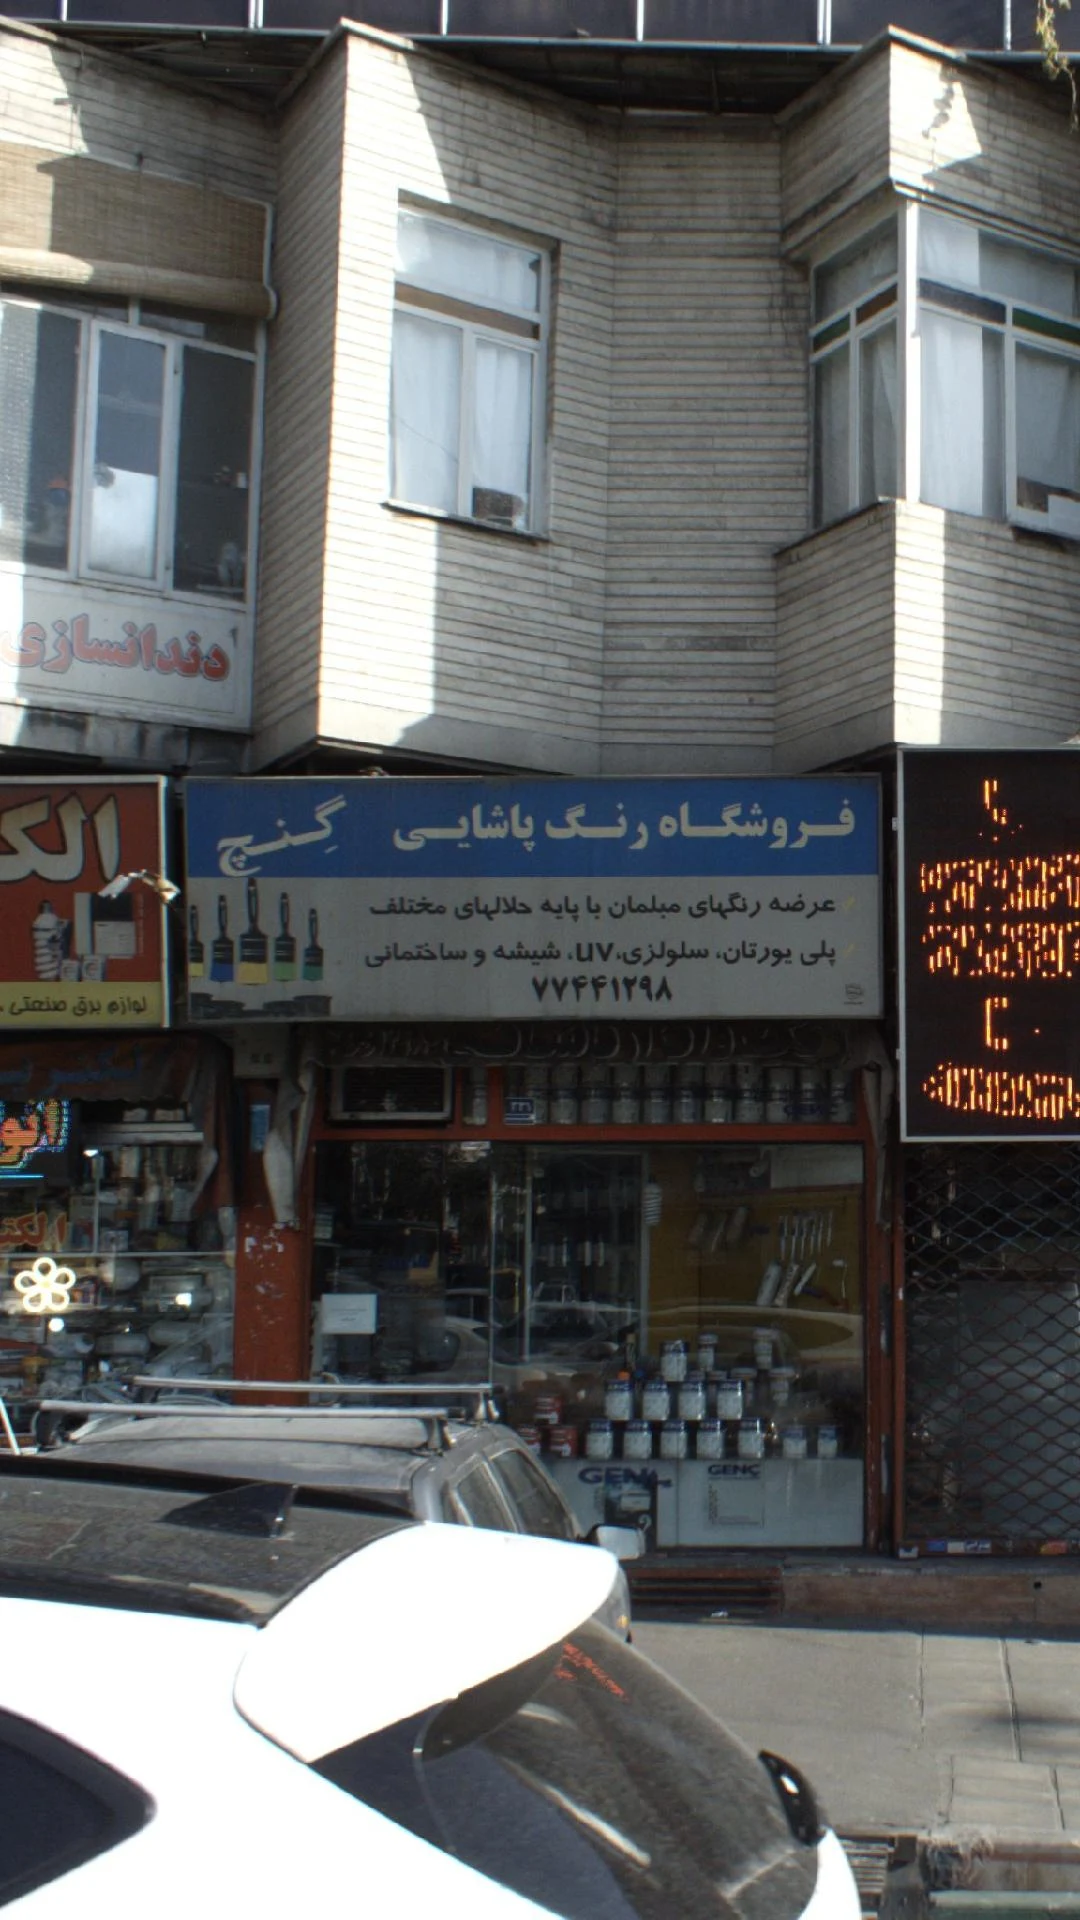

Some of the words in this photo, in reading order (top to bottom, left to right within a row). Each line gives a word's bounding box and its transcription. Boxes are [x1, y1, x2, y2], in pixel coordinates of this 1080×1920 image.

[1, 613, 230, 681] دندانسازی
[0, 791, 120, 884] الک
[393, 803, 536, 852] پاشایی
[544, 802, 650, 850] رنگ
[658, 799, 856, 850] فروشگاه
[369, 896, 447, 916] مختلف
[453, 895, 533, 922] حلالهای
[539, 895, 580, 923] پایه
[586, 895, 602, 920] با
[607, 894, 682, 920] مبلمان
[687, 891, 762, 920] رنگهای
[768, 893, 836, 920] عرضه
[364, 942, 468, 969] ساختمانی
[473, 948, 487, 968] و
[492, 941, 562, 966] شیشه
[800, 939, 836, 967] پلی
[531, 974, 673, 1002] ۷۷۴۴۱۲۹۸
[9, 996, 67, 1016] صنعتی
[72, 996, 102, 1017] برق
[107, 996, 147, 1016] لوازم
